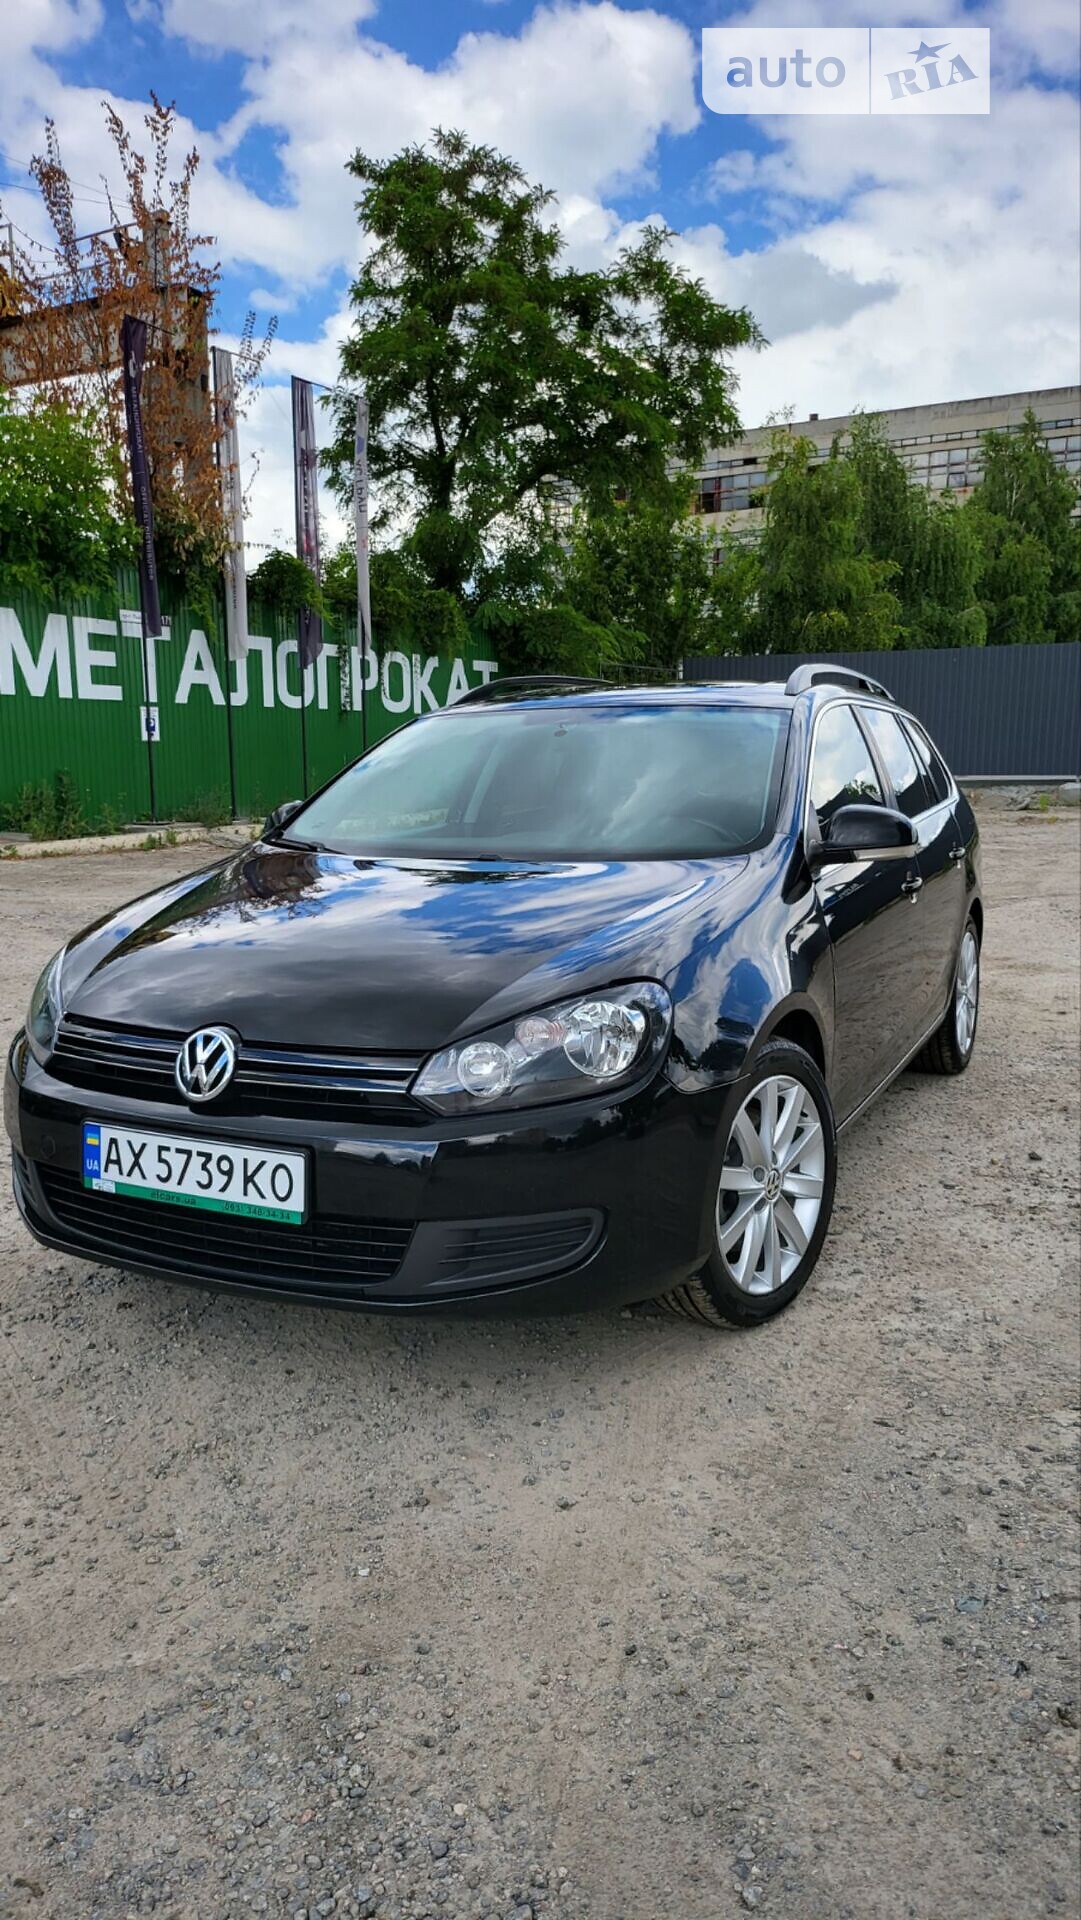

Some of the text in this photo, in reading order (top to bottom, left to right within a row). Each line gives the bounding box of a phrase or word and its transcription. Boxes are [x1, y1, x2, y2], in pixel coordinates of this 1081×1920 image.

[86, 1159, 99, 1171] UA
[104, 1137, 294, 1202] AX 5739 KO
